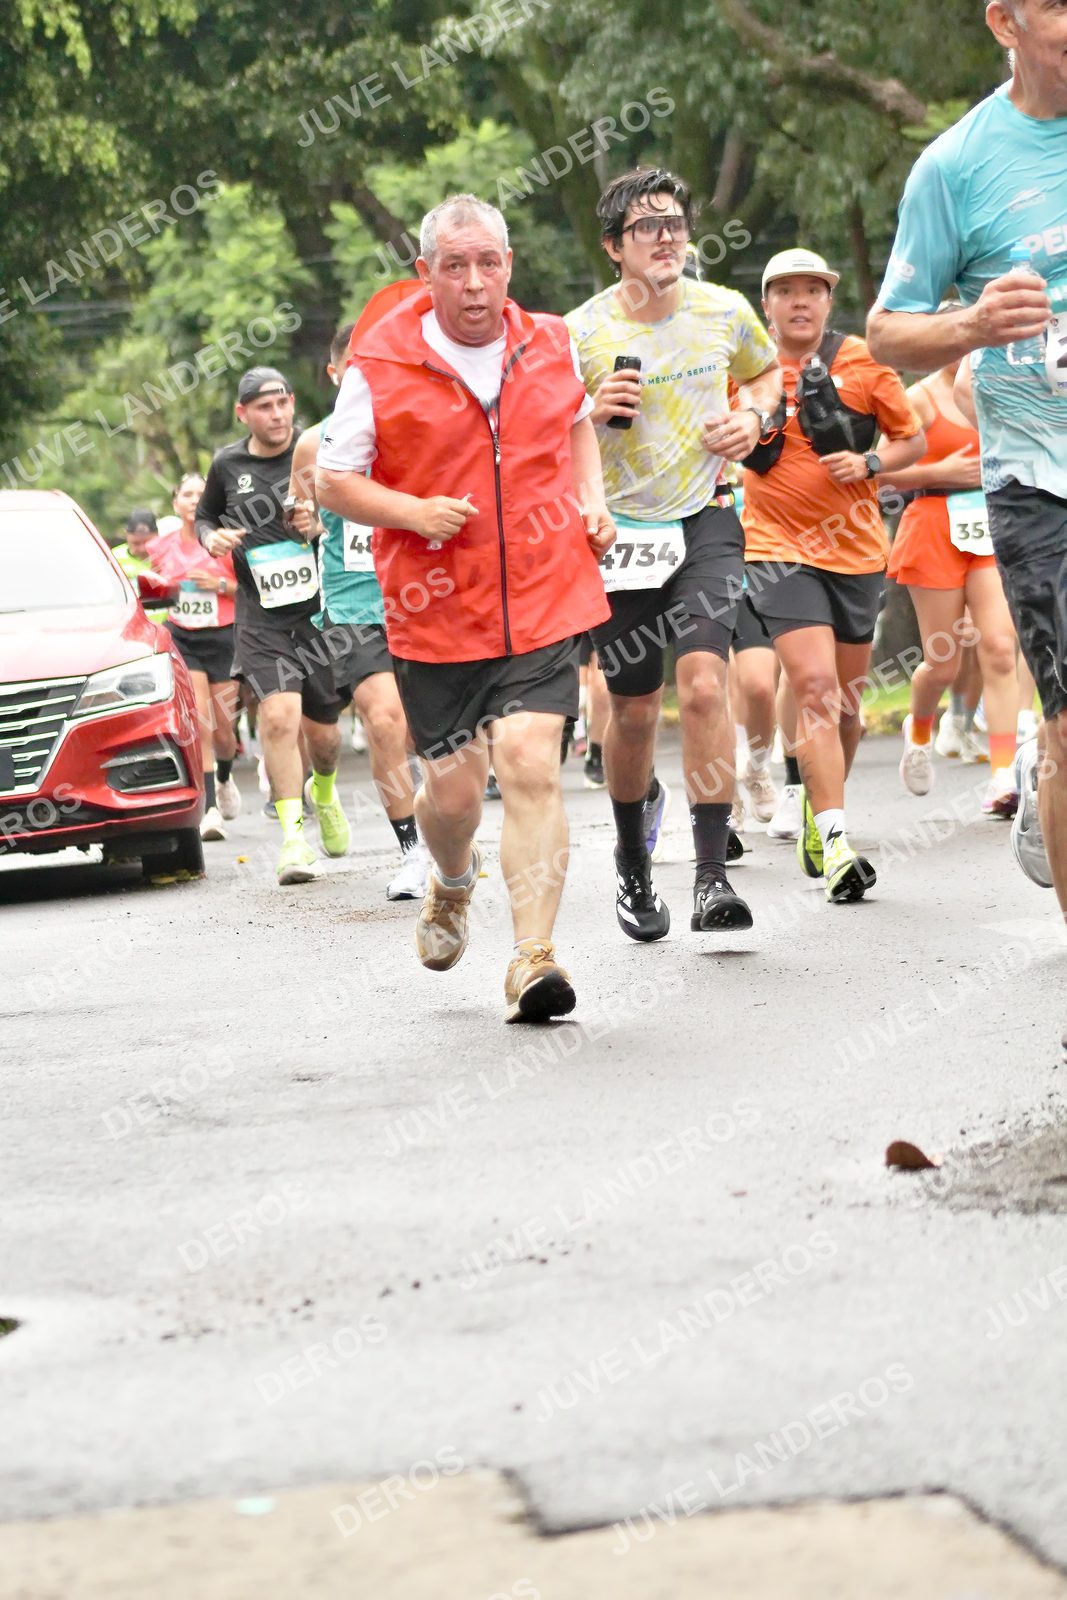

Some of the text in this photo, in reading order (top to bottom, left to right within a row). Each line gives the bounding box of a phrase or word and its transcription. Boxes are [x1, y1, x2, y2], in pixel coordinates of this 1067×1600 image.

[648, 372, 683, 385] MÉXICO
[687, 364, 717, 377] SERIES
[260, 566, 312, 593] 4099
